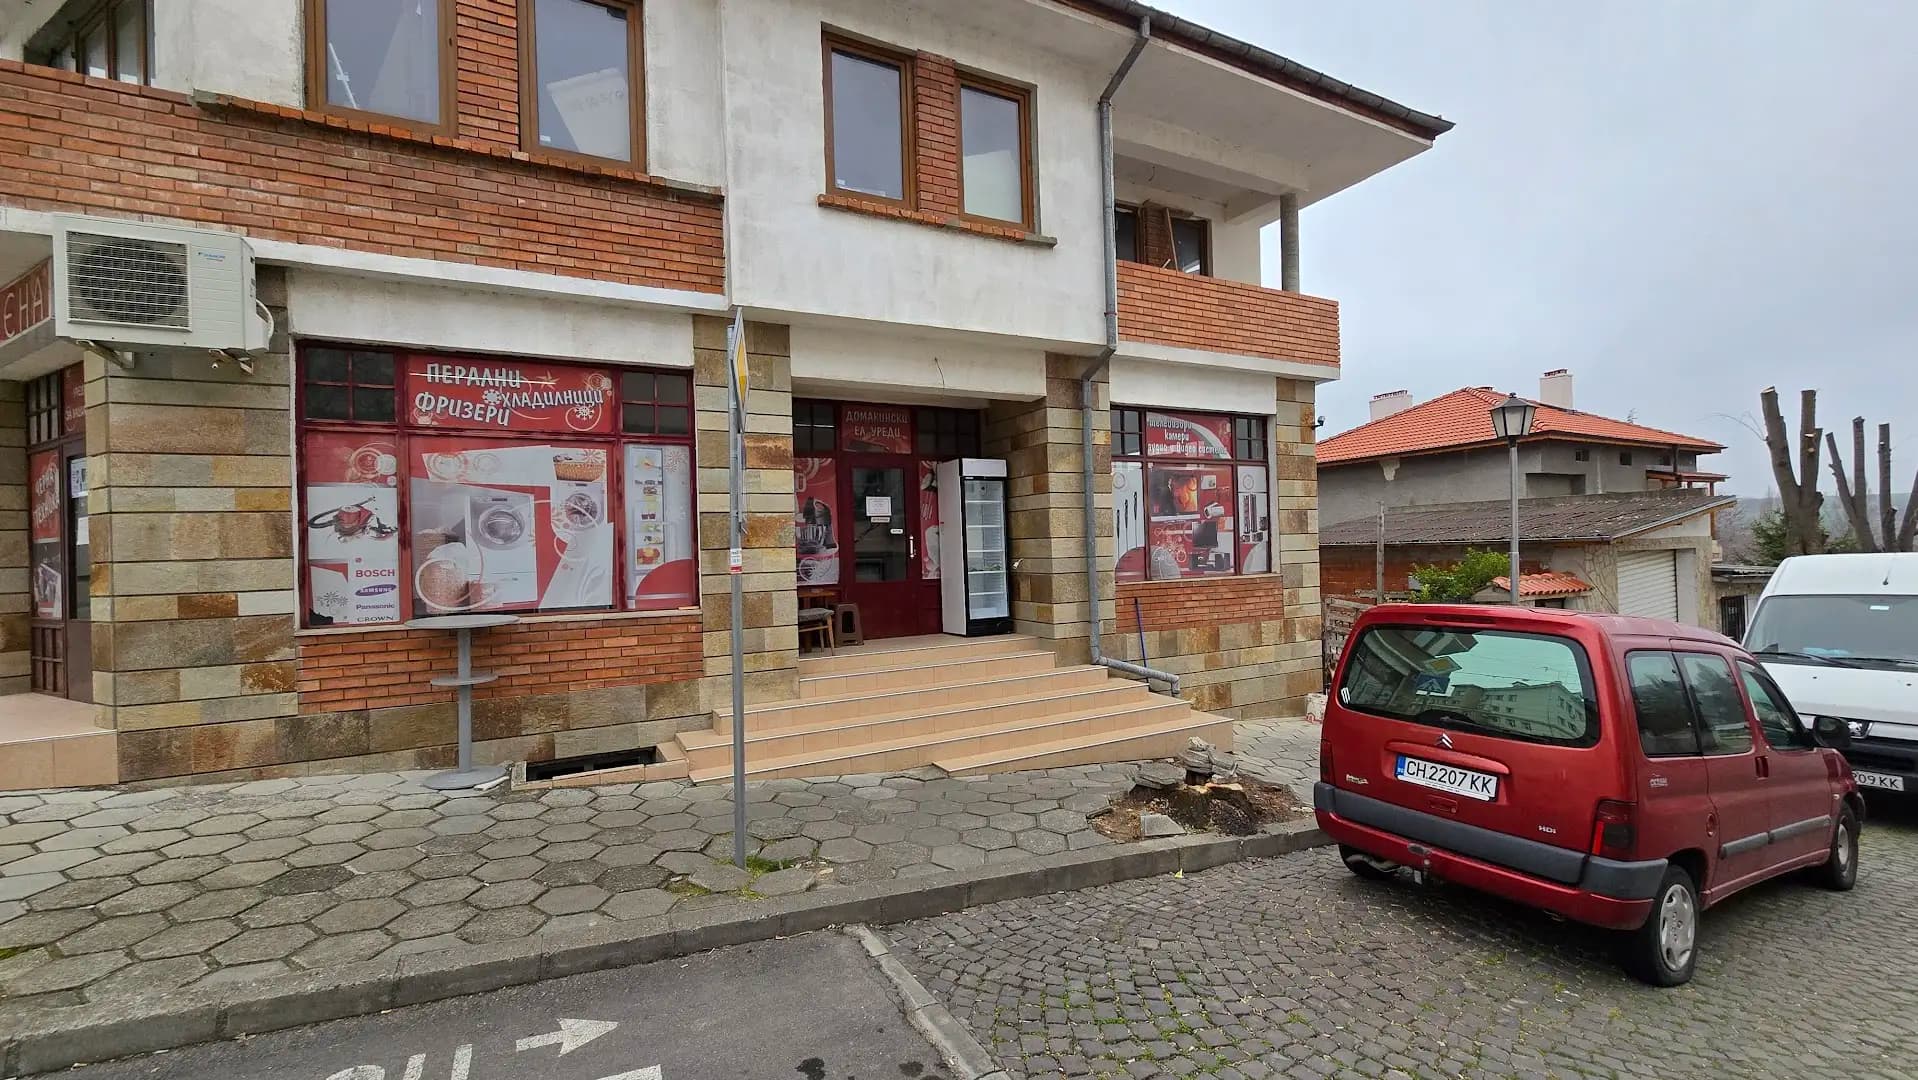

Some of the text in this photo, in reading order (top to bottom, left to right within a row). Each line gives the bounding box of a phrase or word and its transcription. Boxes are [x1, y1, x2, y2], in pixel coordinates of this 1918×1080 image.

[427, 363, 521, 388] ПЕРАЛНИ
[501, 390, 604, 409] ХЛАДИЛНИЦИ
[415, 391, 510, 426] ФРИЗЕРИ
[846, 410, 911, 424] ДОМАКИНСКИ
[871, 427, 901, 439] УРЕДИ
[355, 569, 395, 578] BOSCH
